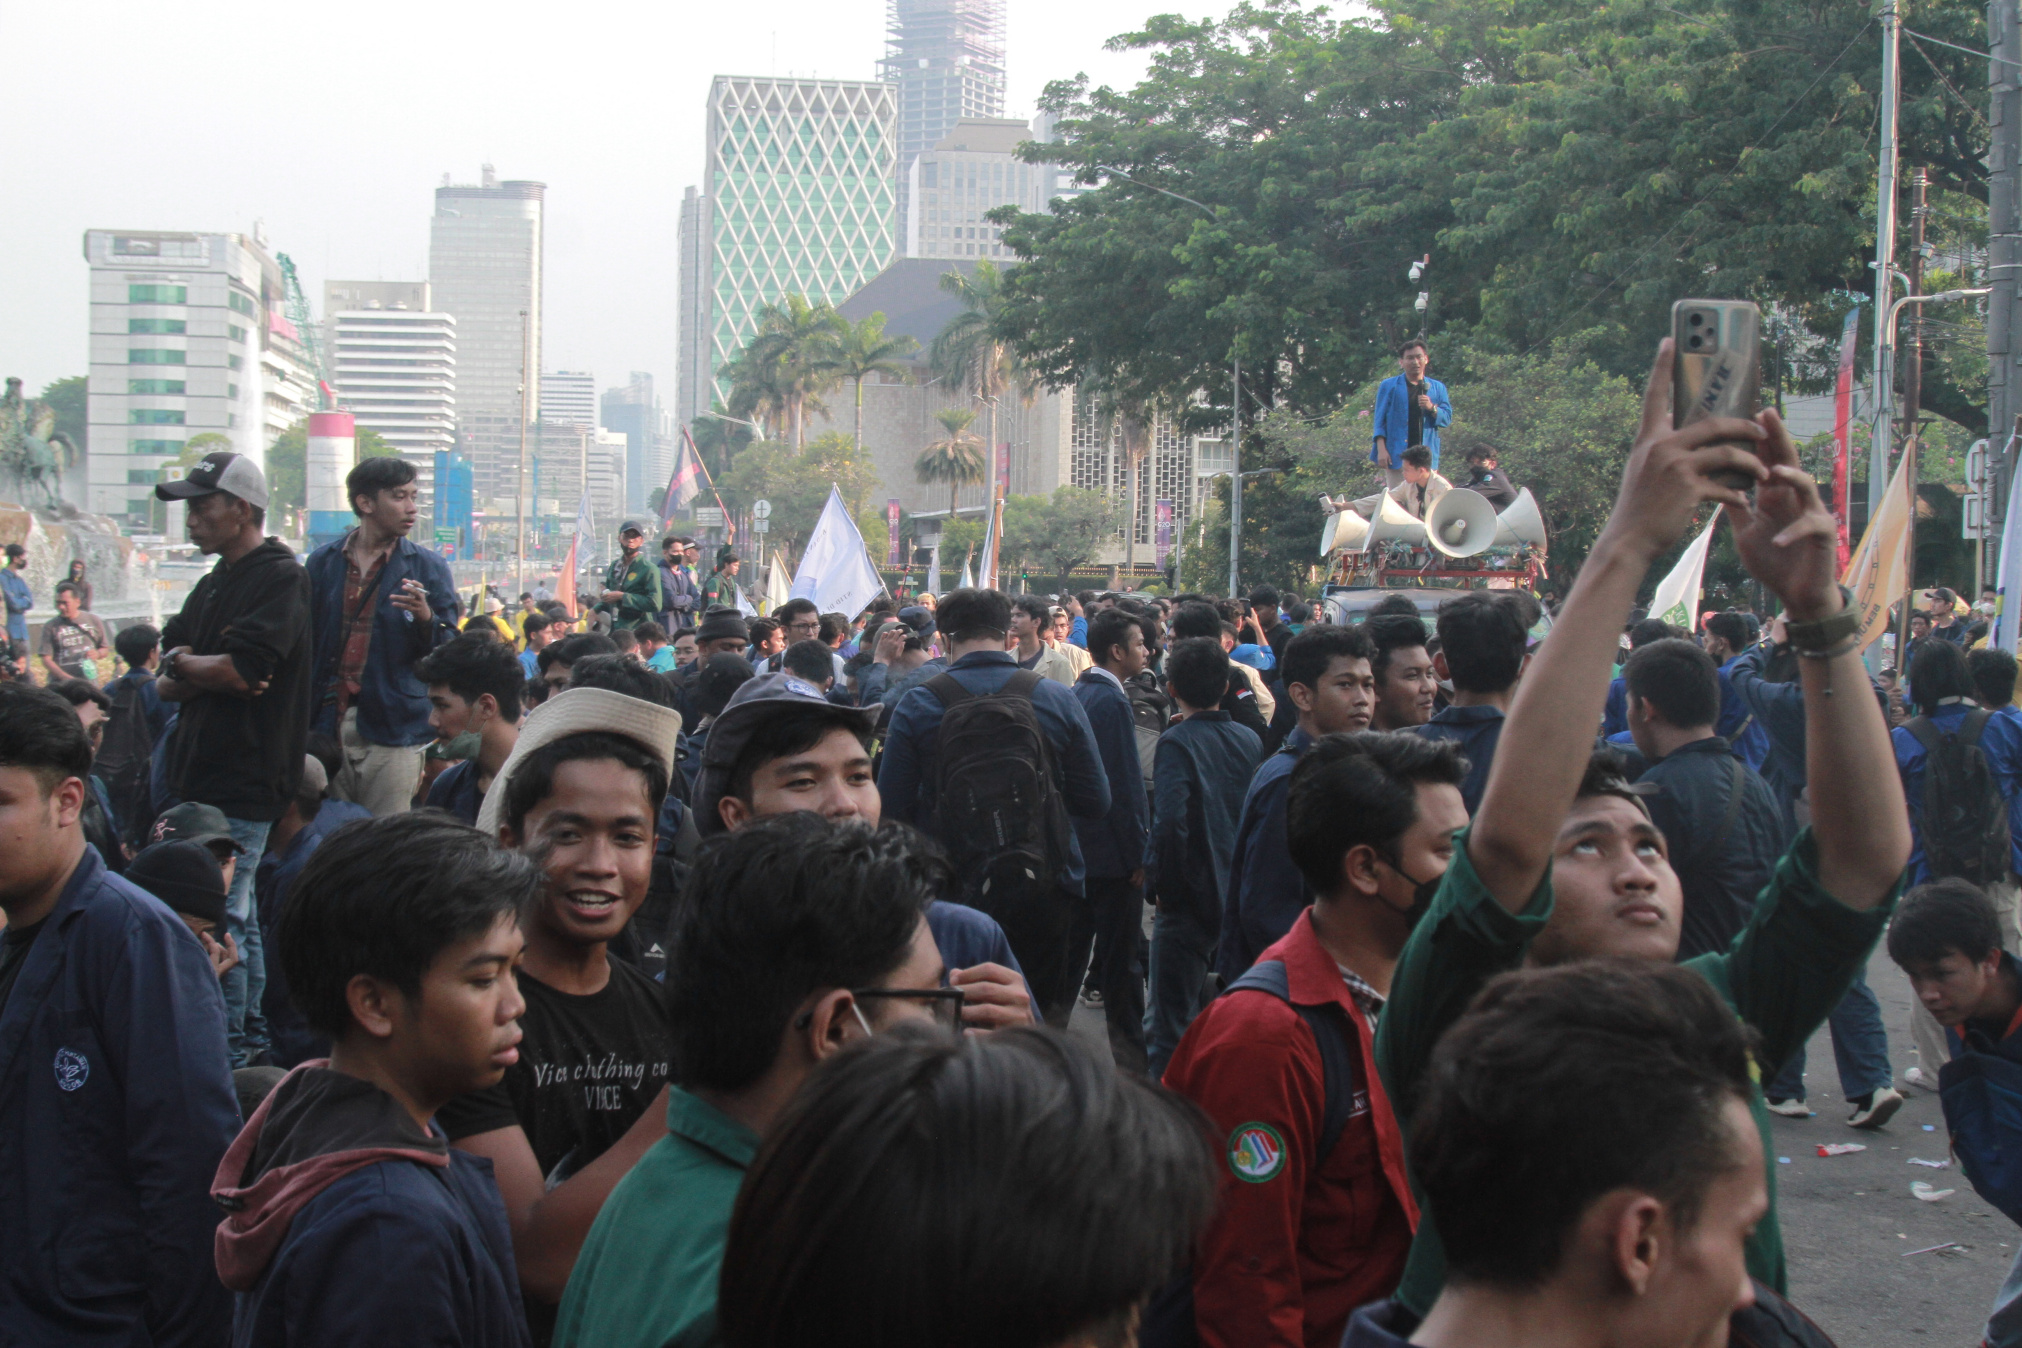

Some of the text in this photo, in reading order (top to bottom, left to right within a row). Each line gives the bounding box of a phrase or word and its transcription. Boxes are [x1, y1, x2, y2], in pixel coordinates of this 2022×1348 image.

[1157, 521, 1171, 529] G20
[534, 1062, 568, 1088] Vice
[584, 1085, 622, 1111] VICE
